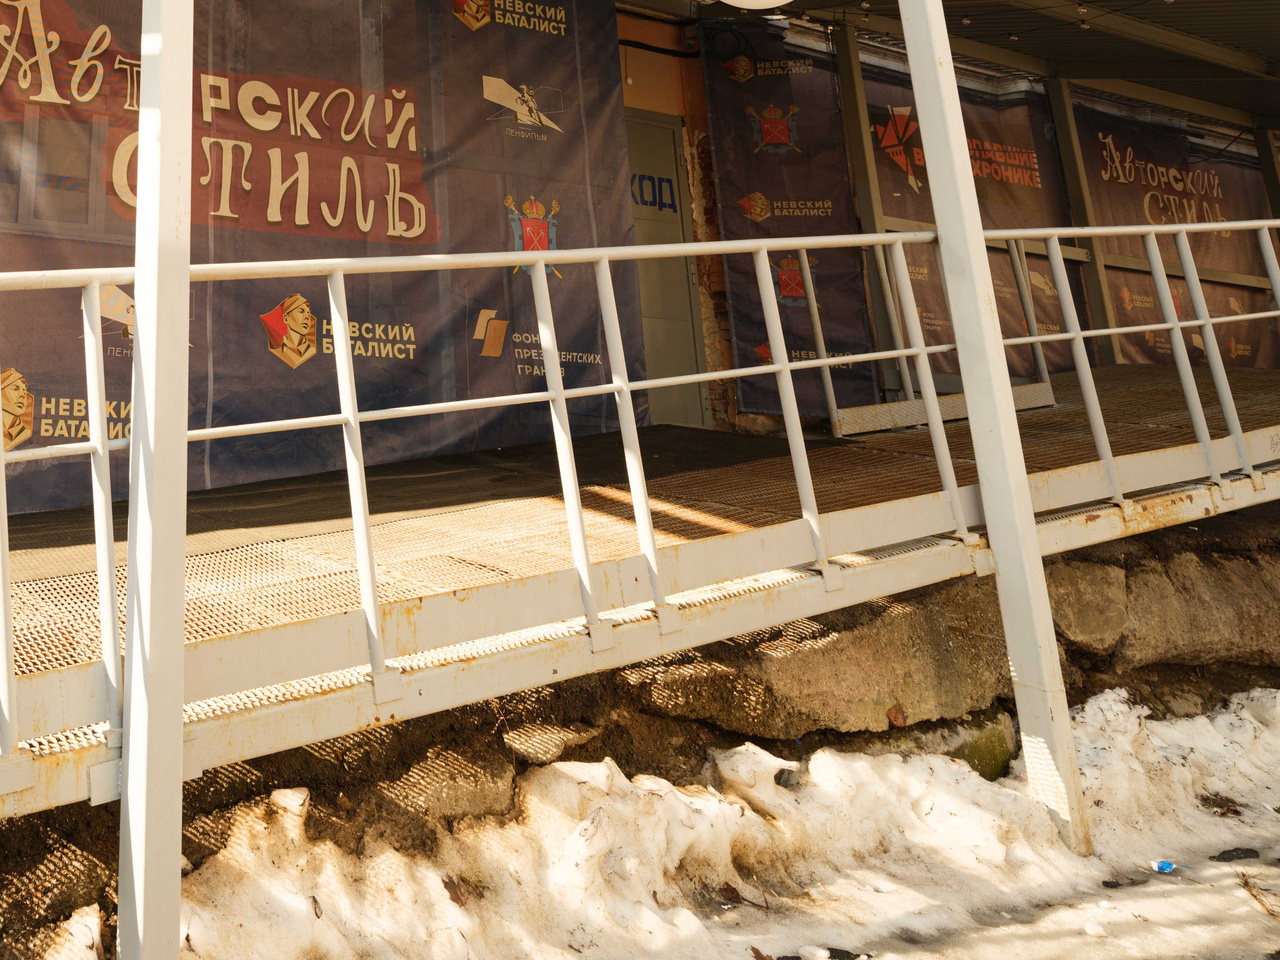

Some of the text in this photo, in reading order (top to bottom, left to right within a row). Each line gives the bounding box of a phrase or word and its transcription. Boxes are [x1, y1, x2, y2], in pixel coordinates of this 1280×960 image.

[495, 10, 567, 36] БАТАЛИСТ
[756, 58, 814, 69] НЕВСКИЙ
[757, 66, 814, 76] БАТАЛИСТ
[505, 127, 548, 141] ЛЕНФИЛЬМ
[970, 159, 1041, 188] ХРОНИКЕ
[773, 199, 833, 208] НЕВСКИЙ
[774, 208, 833, 216] БАТАЛИСТ
[322, 319, 416, 341] НВСКИЙ
[512, 332, 541, 344] ФОН
[322, 338, 417, 360] БАЛИСТ
[41, 397, 132, 418] НЕВКИ
